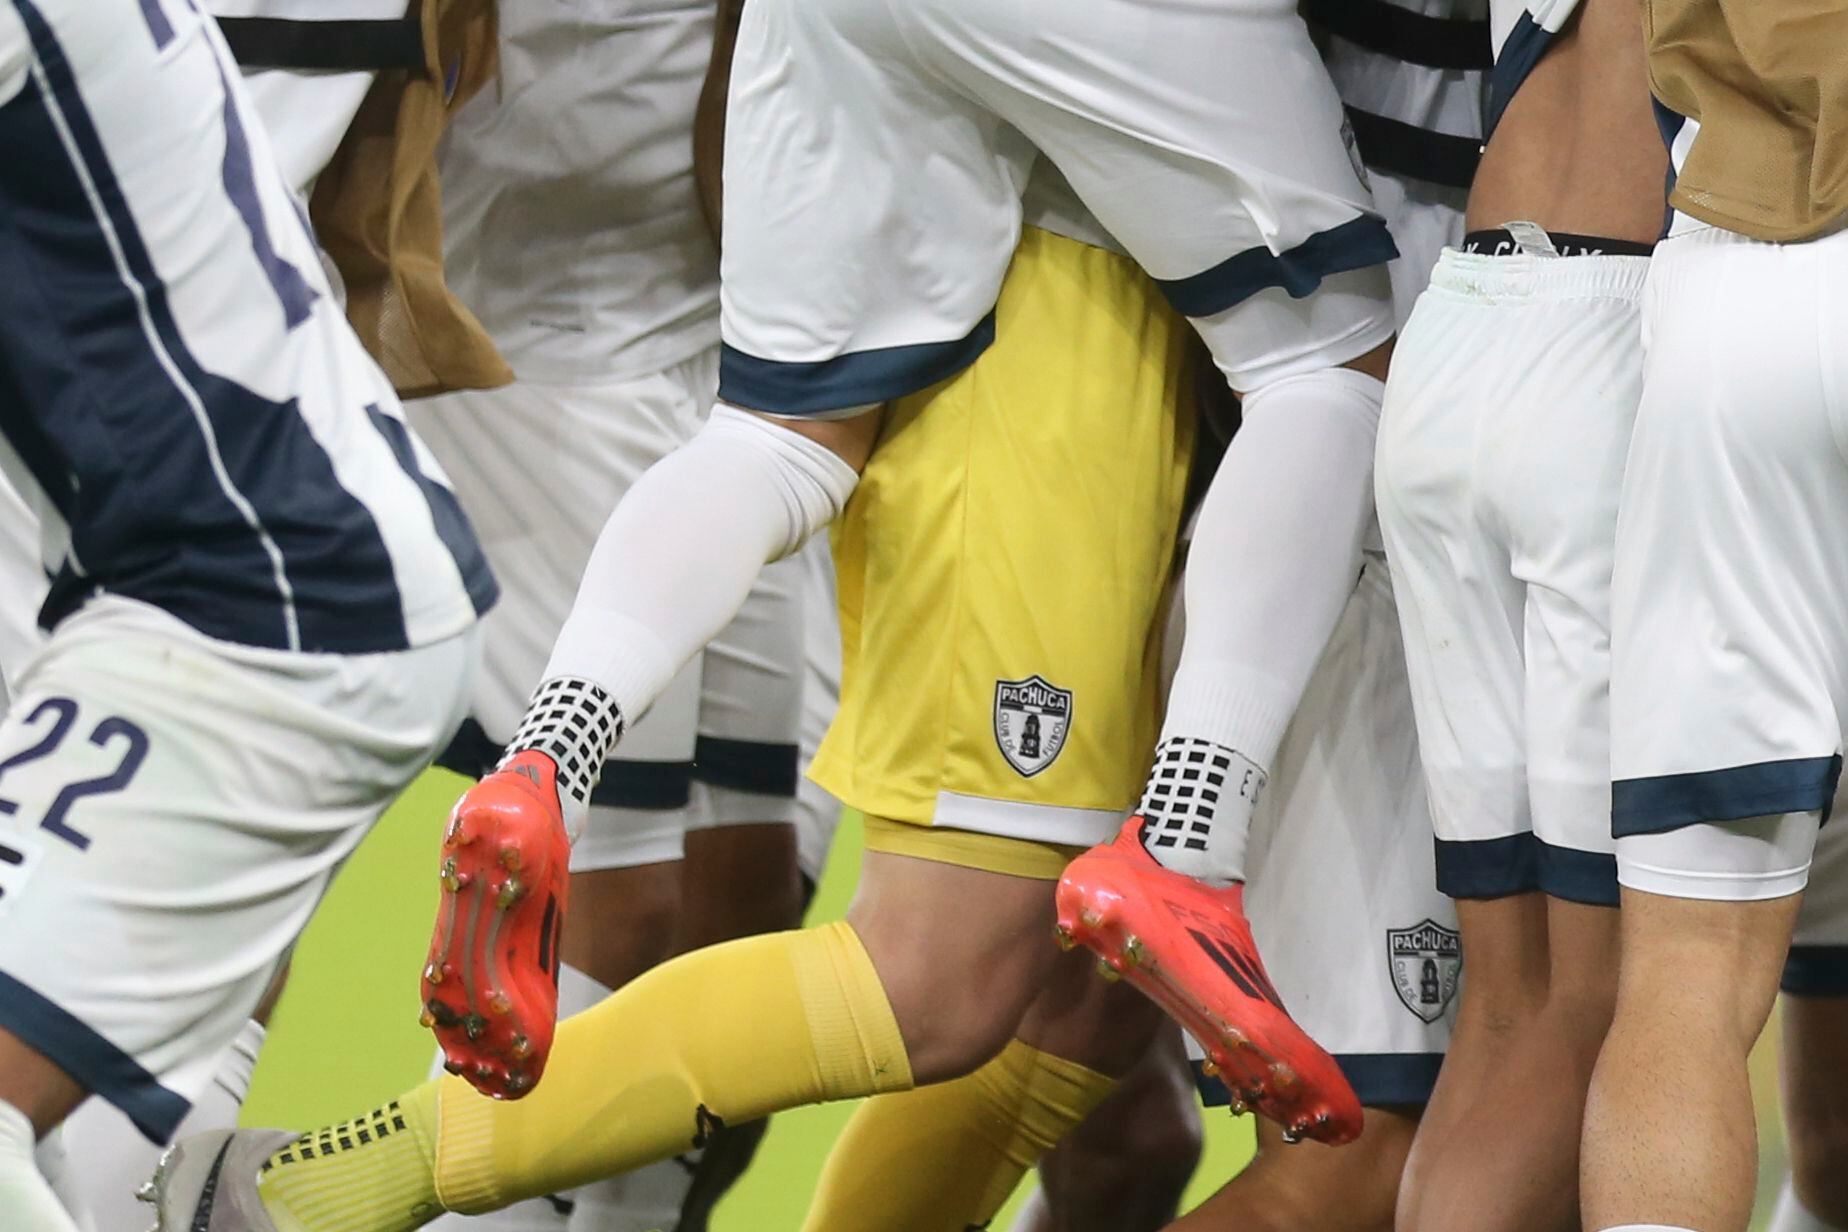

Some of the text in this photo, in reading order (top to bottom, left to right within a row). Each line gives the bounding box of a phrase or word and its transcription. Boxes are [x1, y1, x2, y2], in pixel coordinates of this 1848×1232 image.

[1002, 686, 1066, 709] PACHUCA
[0, 698, 149, 851] 22
[1394, 930, 1458, 950] PACHUCA
